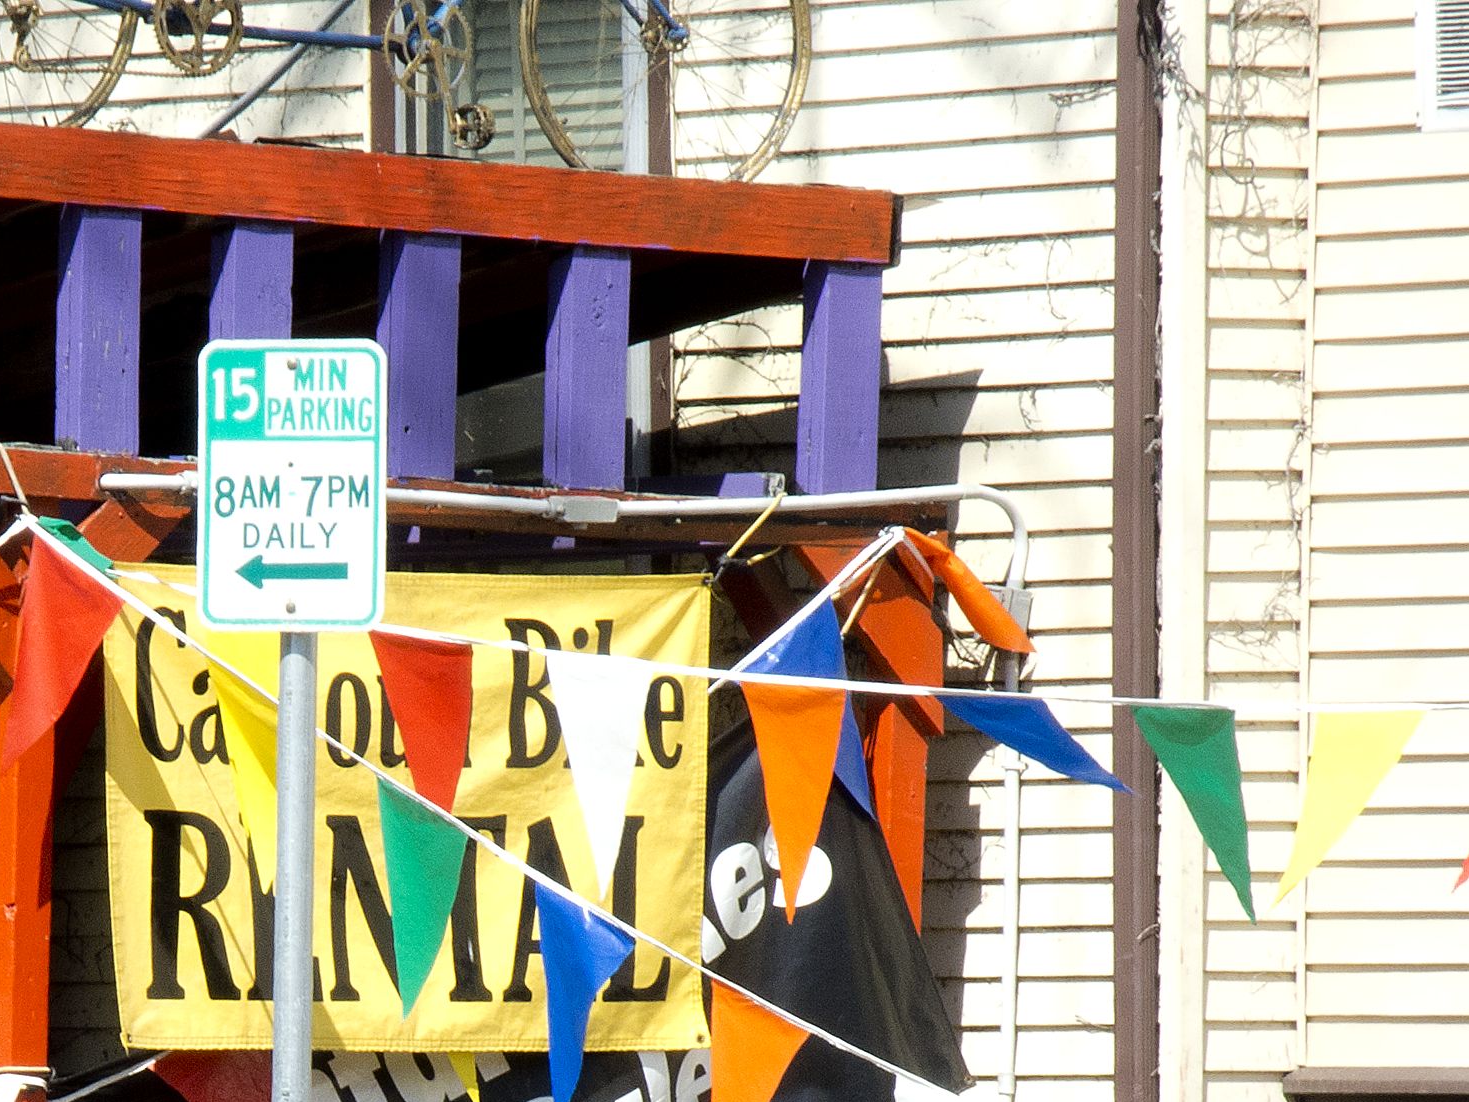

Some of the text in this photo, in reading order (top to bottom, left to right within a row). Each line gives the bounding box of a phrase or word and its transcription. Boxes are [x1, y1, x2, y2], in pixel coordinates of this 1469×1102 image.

[211, 358, 347, 422] 15 MIN
[267, 397, 373, 432] PARKING
[214, 475, 370, 518] 8AM 7PM
[243, 522, 337, 549] DAILY
